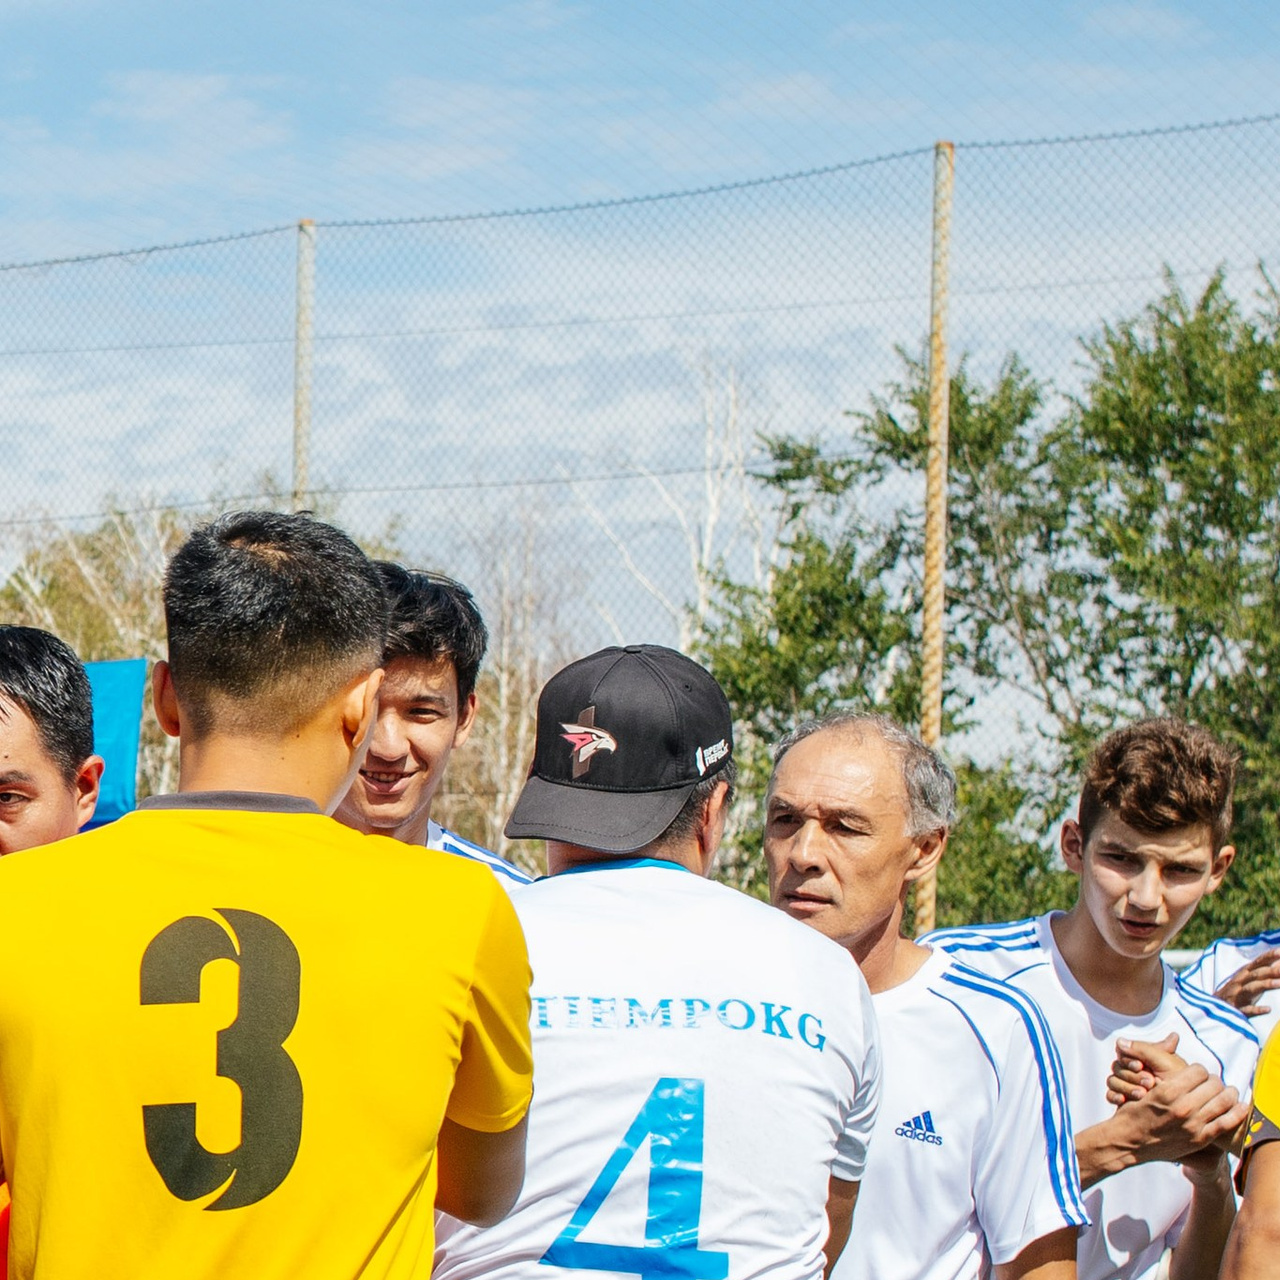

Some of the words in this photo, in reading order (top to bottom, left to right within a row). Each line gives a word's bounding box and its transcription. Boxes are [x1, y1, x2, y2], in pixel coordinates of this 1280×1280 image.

[531, 996, 827, 1052] TIEMPOKG
[140, 908, 303, 1211] 3
[894, 1127, 943, 1145] adidas
